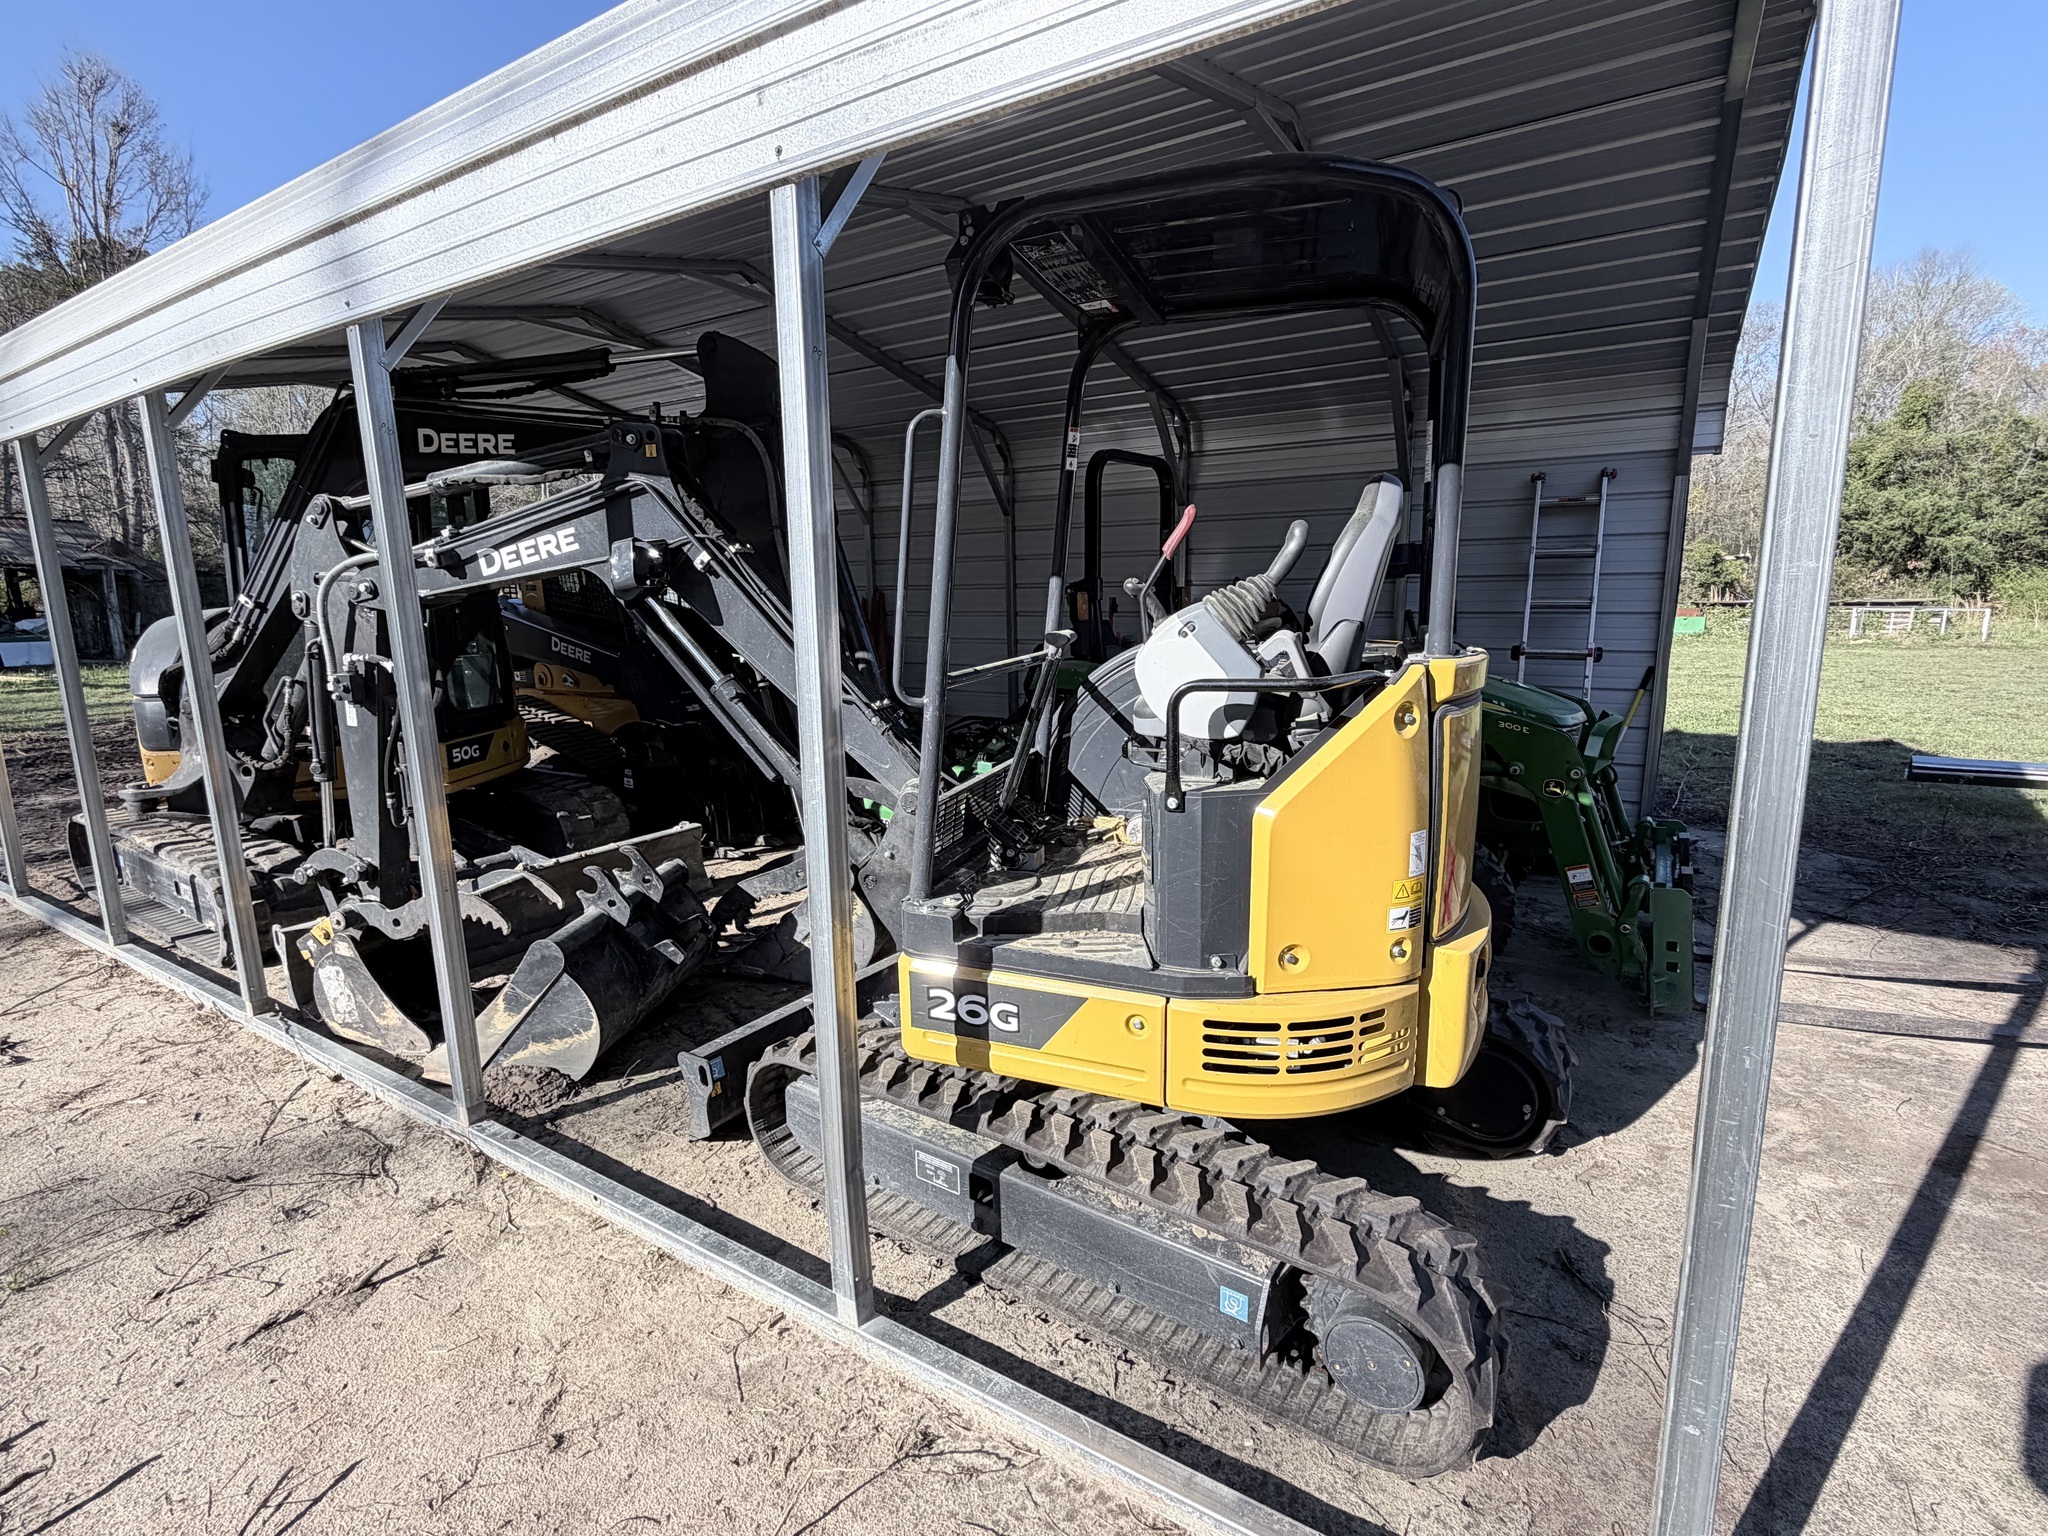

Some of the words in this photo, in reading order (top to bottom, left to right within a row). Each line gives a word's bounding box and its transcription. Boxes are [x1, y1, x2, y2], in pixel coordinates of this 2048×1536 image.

[417, 428, 516, 455] DEERE
[476, 526, 580, 577] DEERE
[551, 636, 592, 664] DEERE
[452, 744, 480, 763] 50G
[928, 987, 1020, 1032] 26G
